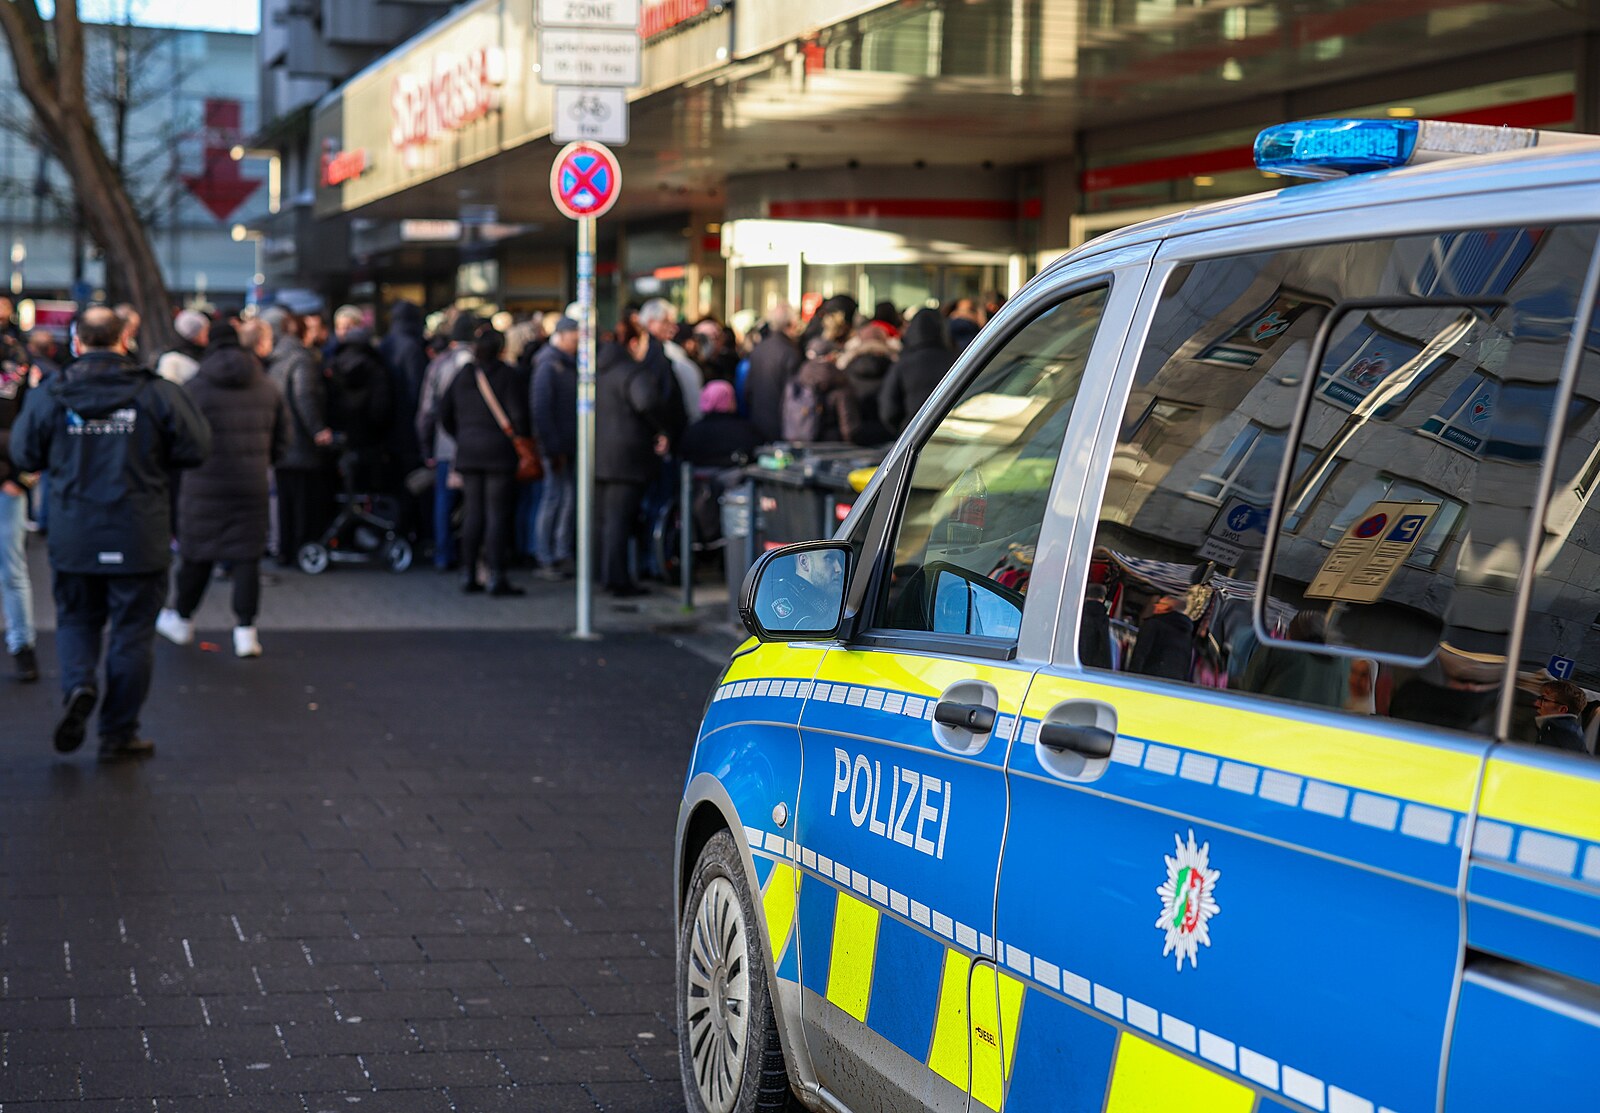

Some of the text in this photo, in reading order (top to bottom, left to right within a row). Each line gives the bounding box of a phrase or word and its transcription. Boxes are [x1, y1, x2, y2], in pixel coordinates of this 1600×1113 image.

[563, 1, 614, 19] ZONE
[67, 425, 135, 434] SECURITY
[830, 747, 952, 860] POLIZEI
[977, 1027, 997, 1047] DIESEL
